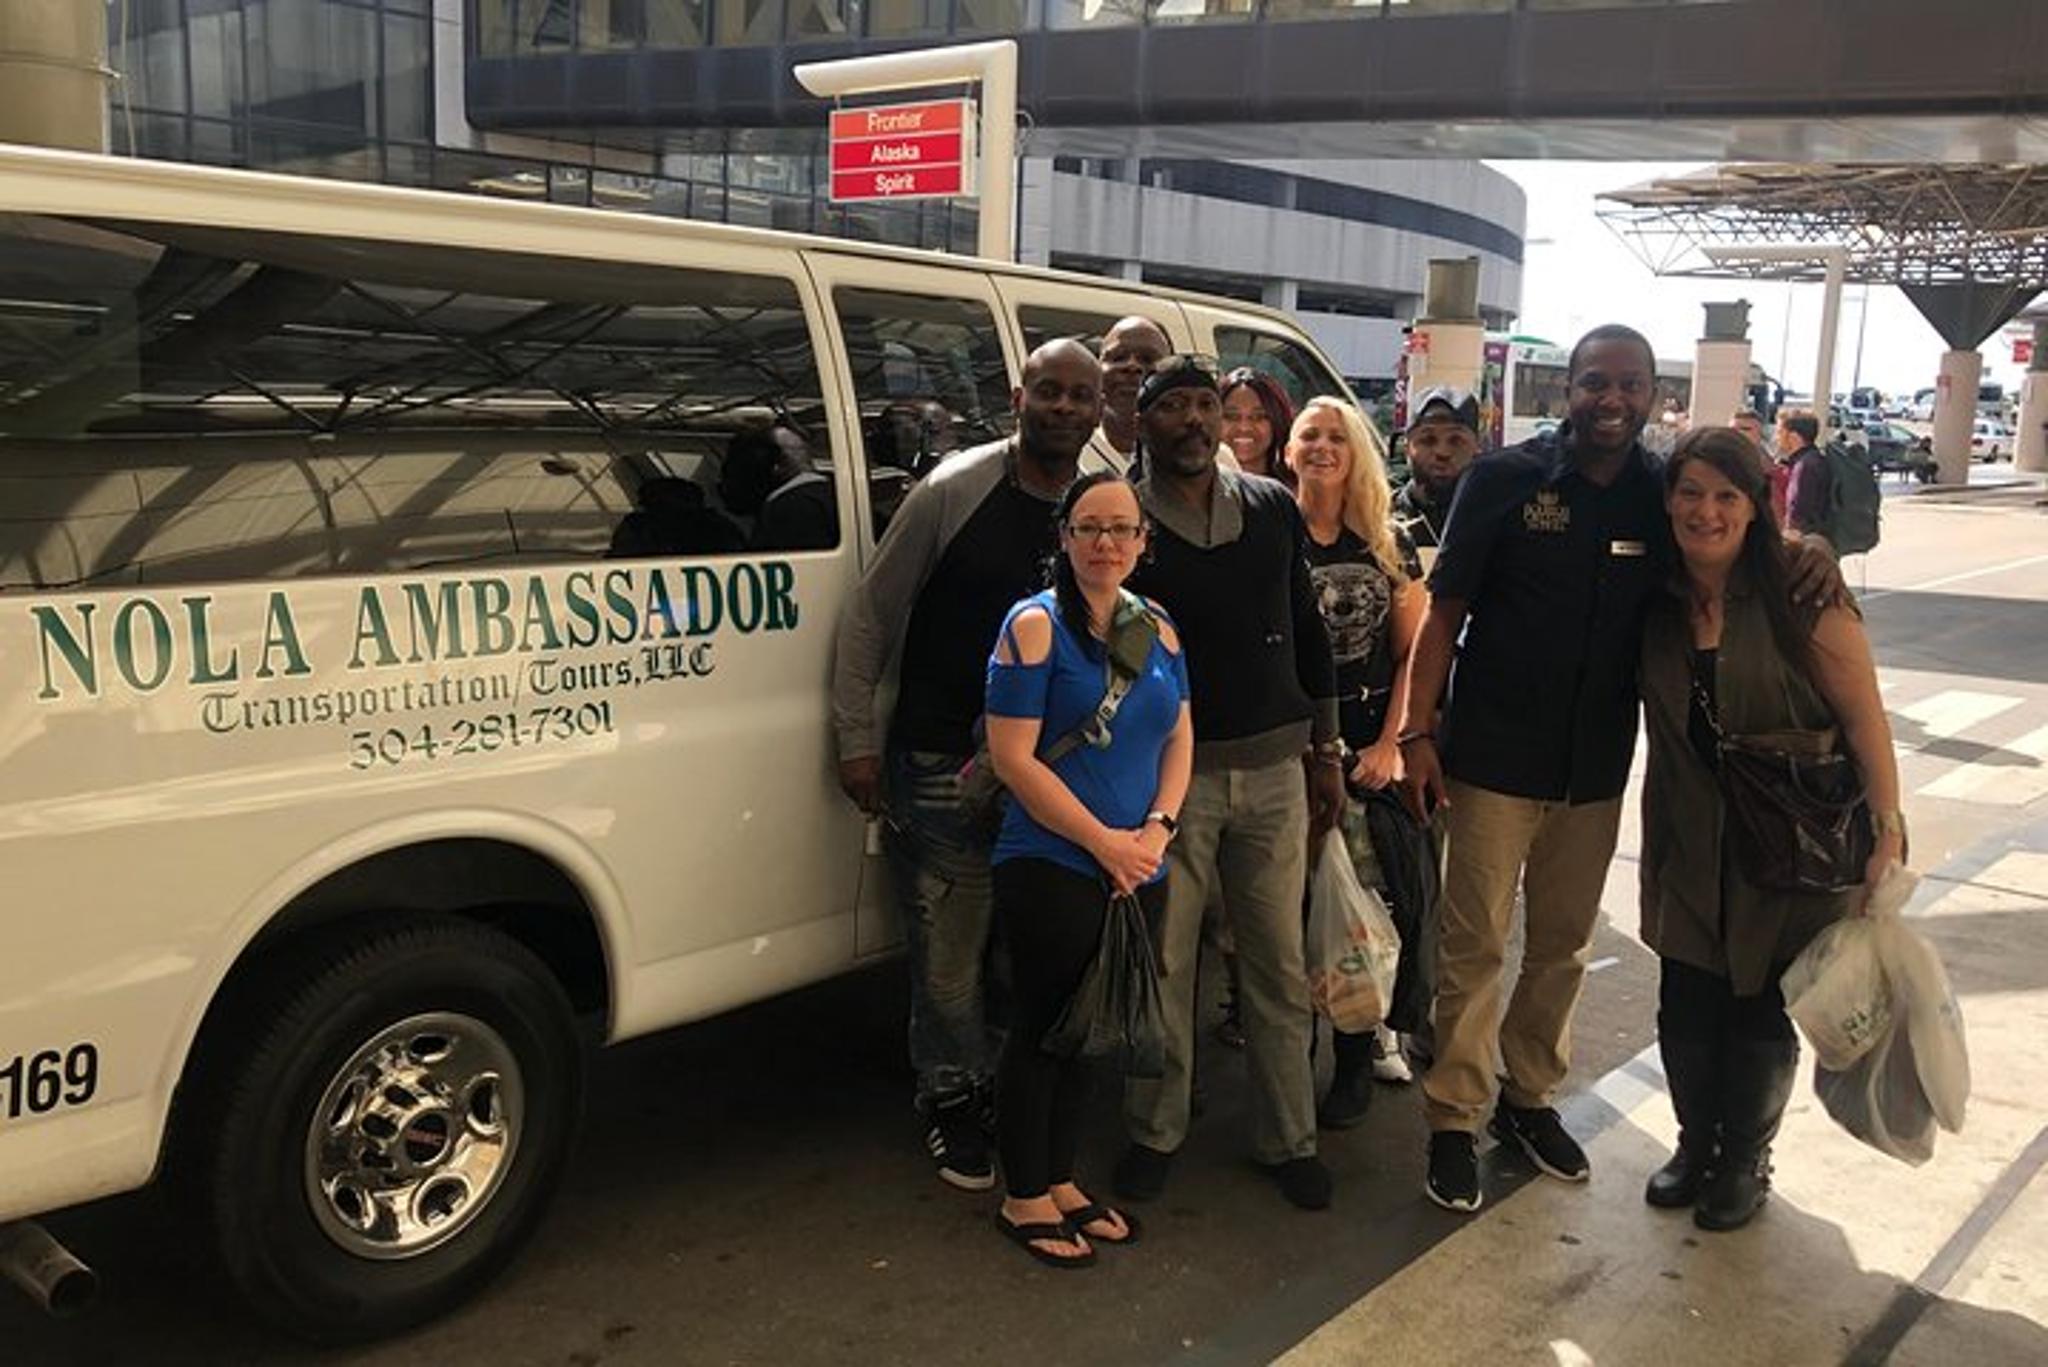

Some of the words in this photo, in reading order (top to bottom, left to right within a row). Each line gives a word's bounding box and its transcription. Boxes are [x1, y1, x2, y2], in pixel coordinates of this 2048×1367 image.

[867, 112, 922, 132] Frontier
[870, 143, 920, 163] Alaska
[875, 173, 914, 194] Spirit
[30, 591, 311, 699] NOLA
[347, 560, 799, 669] AMBASSADOR
[351, 700, 613, 769] 504-281-7301
